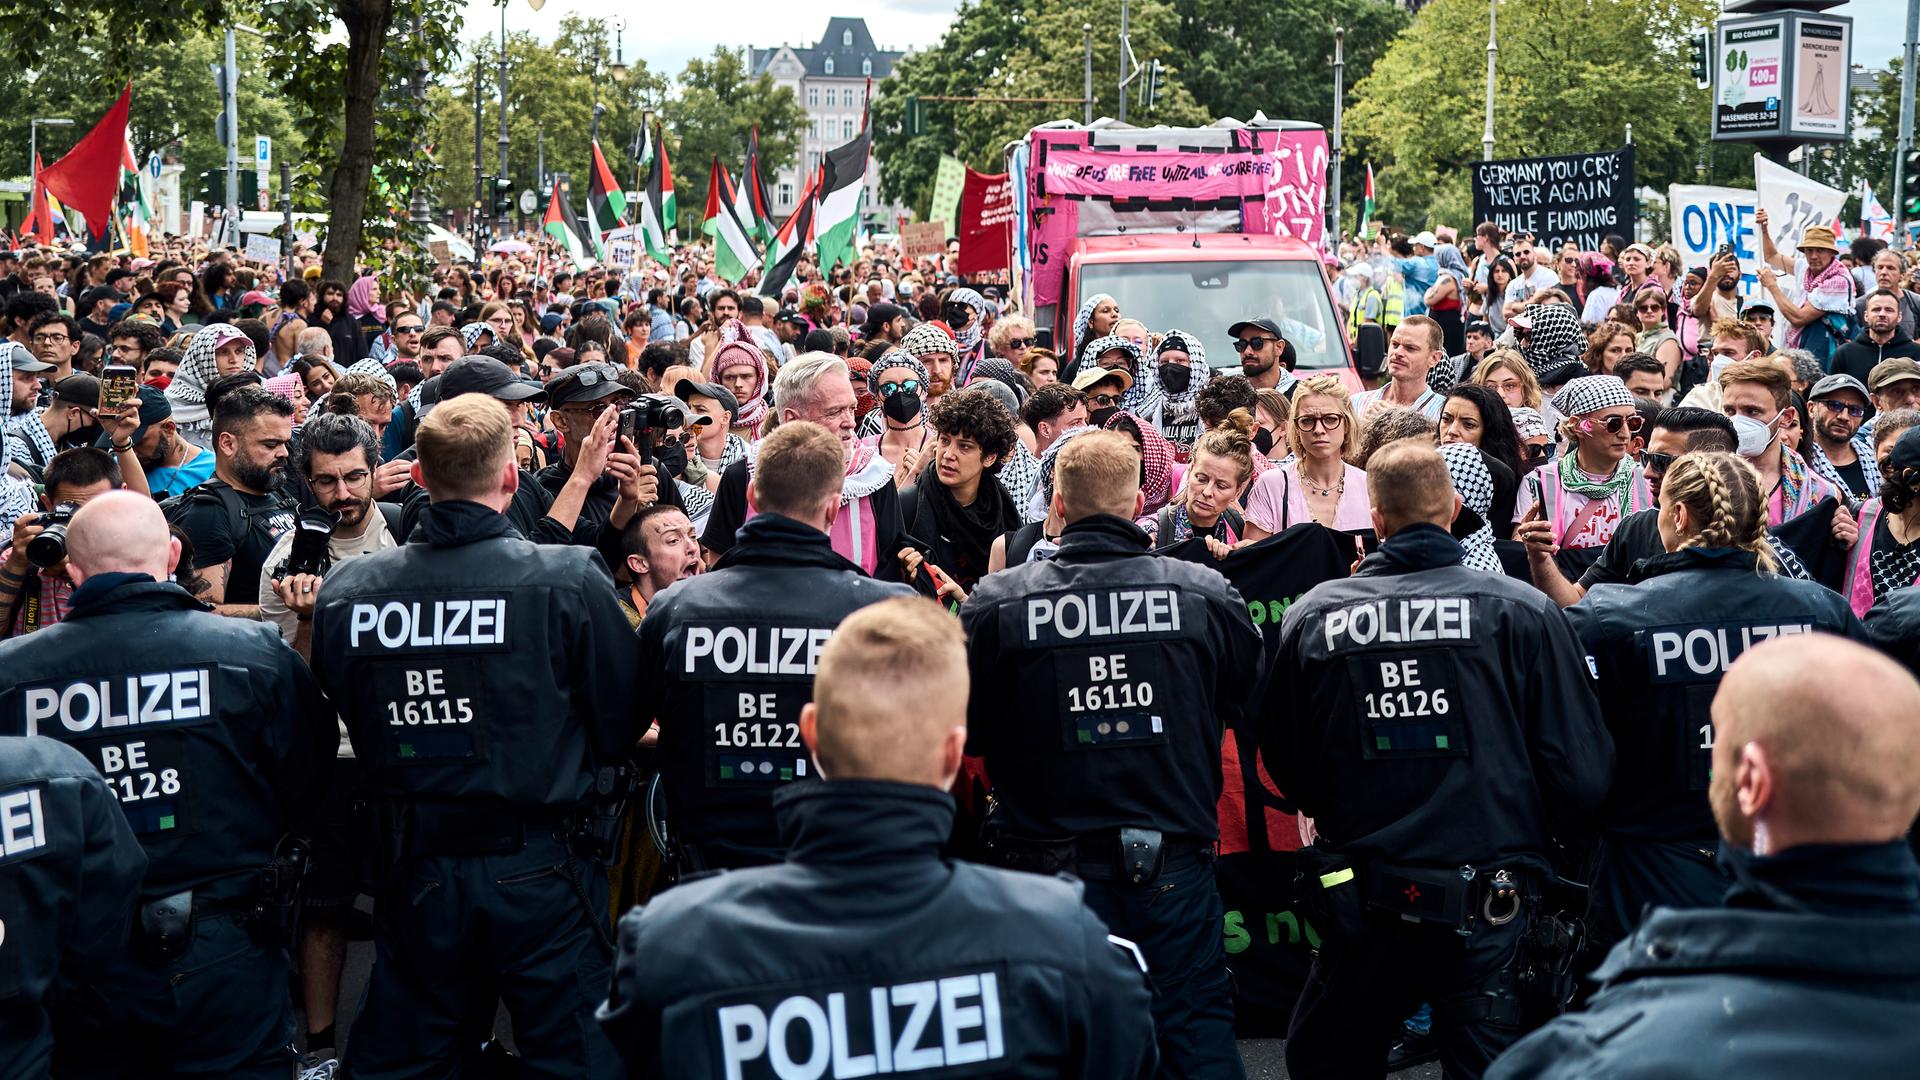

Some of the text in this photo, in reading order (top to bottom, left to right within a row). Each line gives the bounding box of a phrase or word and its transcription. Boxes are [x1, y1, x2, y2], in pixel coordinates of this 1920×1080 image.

[1743, 29, 1773, 39] COMPANY
[1751, 68, 1776, 84] 400m
[1128, 165, 1156, 182] FREE
[1480, 154, 1620, 186] GERMANY, YOU CRY:
[1484, 184, 1542, 206] "NEVER
[1547, 205, 1617, 232] FUNDING
[1683, 202, 1755, 260] ONE
[28, 597, 38, 624] Nikon
[350, 598, 507, 649] POLIZEI
[1028, 589, 1182, 642] POLIZEI
[1325, 597, 1472, 653] POLIZEI
[684, 625, 838, 676] POLIZE
[1652, 623, 1812, 676] POLI
[405, 668, 447, 697] BE
[1089, 654, 1129, 682] BE
[1380, 659, 1422, 688] BE
[25, 668, 211, 737] POLIZEI
[386, 697, 474, 726] 16115
[738, 692, 779, 719] BE
[1068, 682, 1154, 713] 16110
[1364, 688, 1450, 719] 16126
[714, 722, 802, 749] 16122
[101, 741, 150, 774] BE
[0, 788, 47, 858] EI
[718, 971, 1006, 1080] POLIZEI
